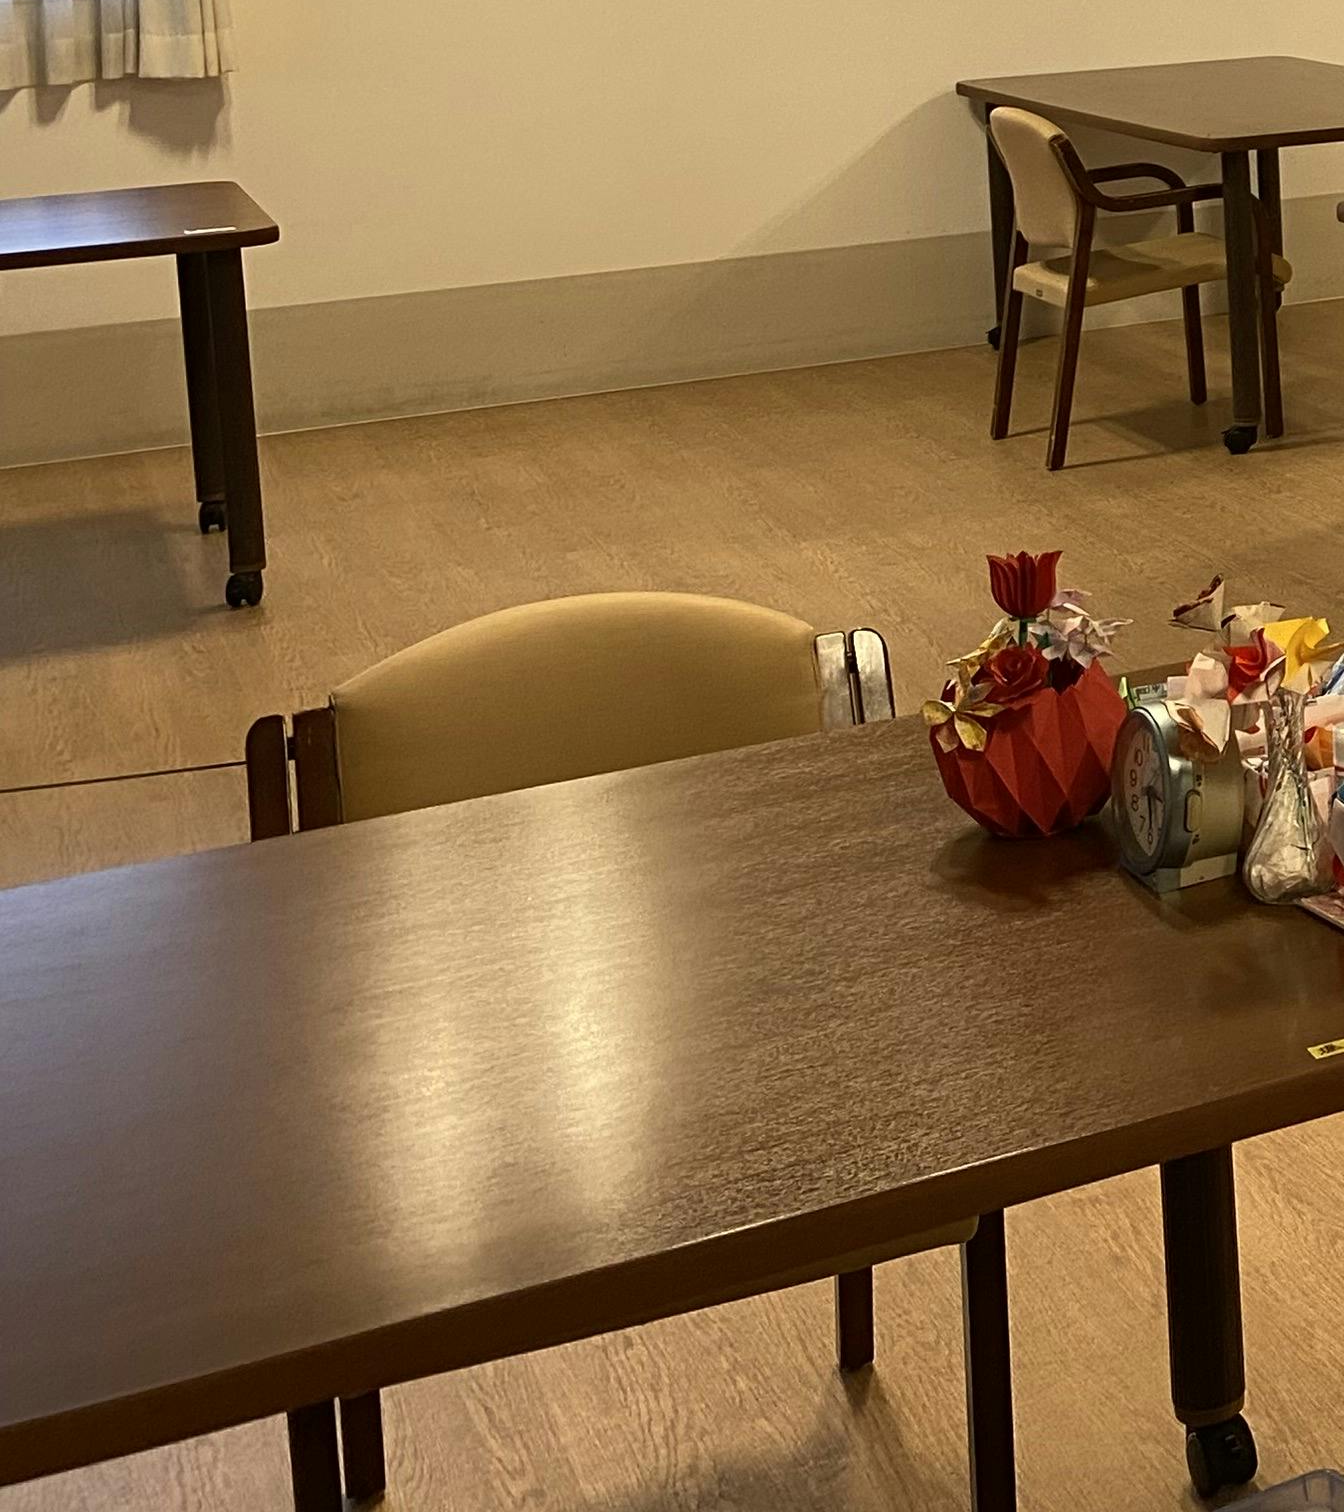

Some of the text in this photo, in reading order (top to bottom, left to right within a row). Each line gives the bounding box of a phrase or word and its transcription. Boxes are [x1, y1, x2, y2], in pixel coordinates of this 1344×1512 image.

[1130, 769, 1137, 787] 9
[1131, 793, 1139, 812] 8
[1139, 814, 1146, 833] 7
